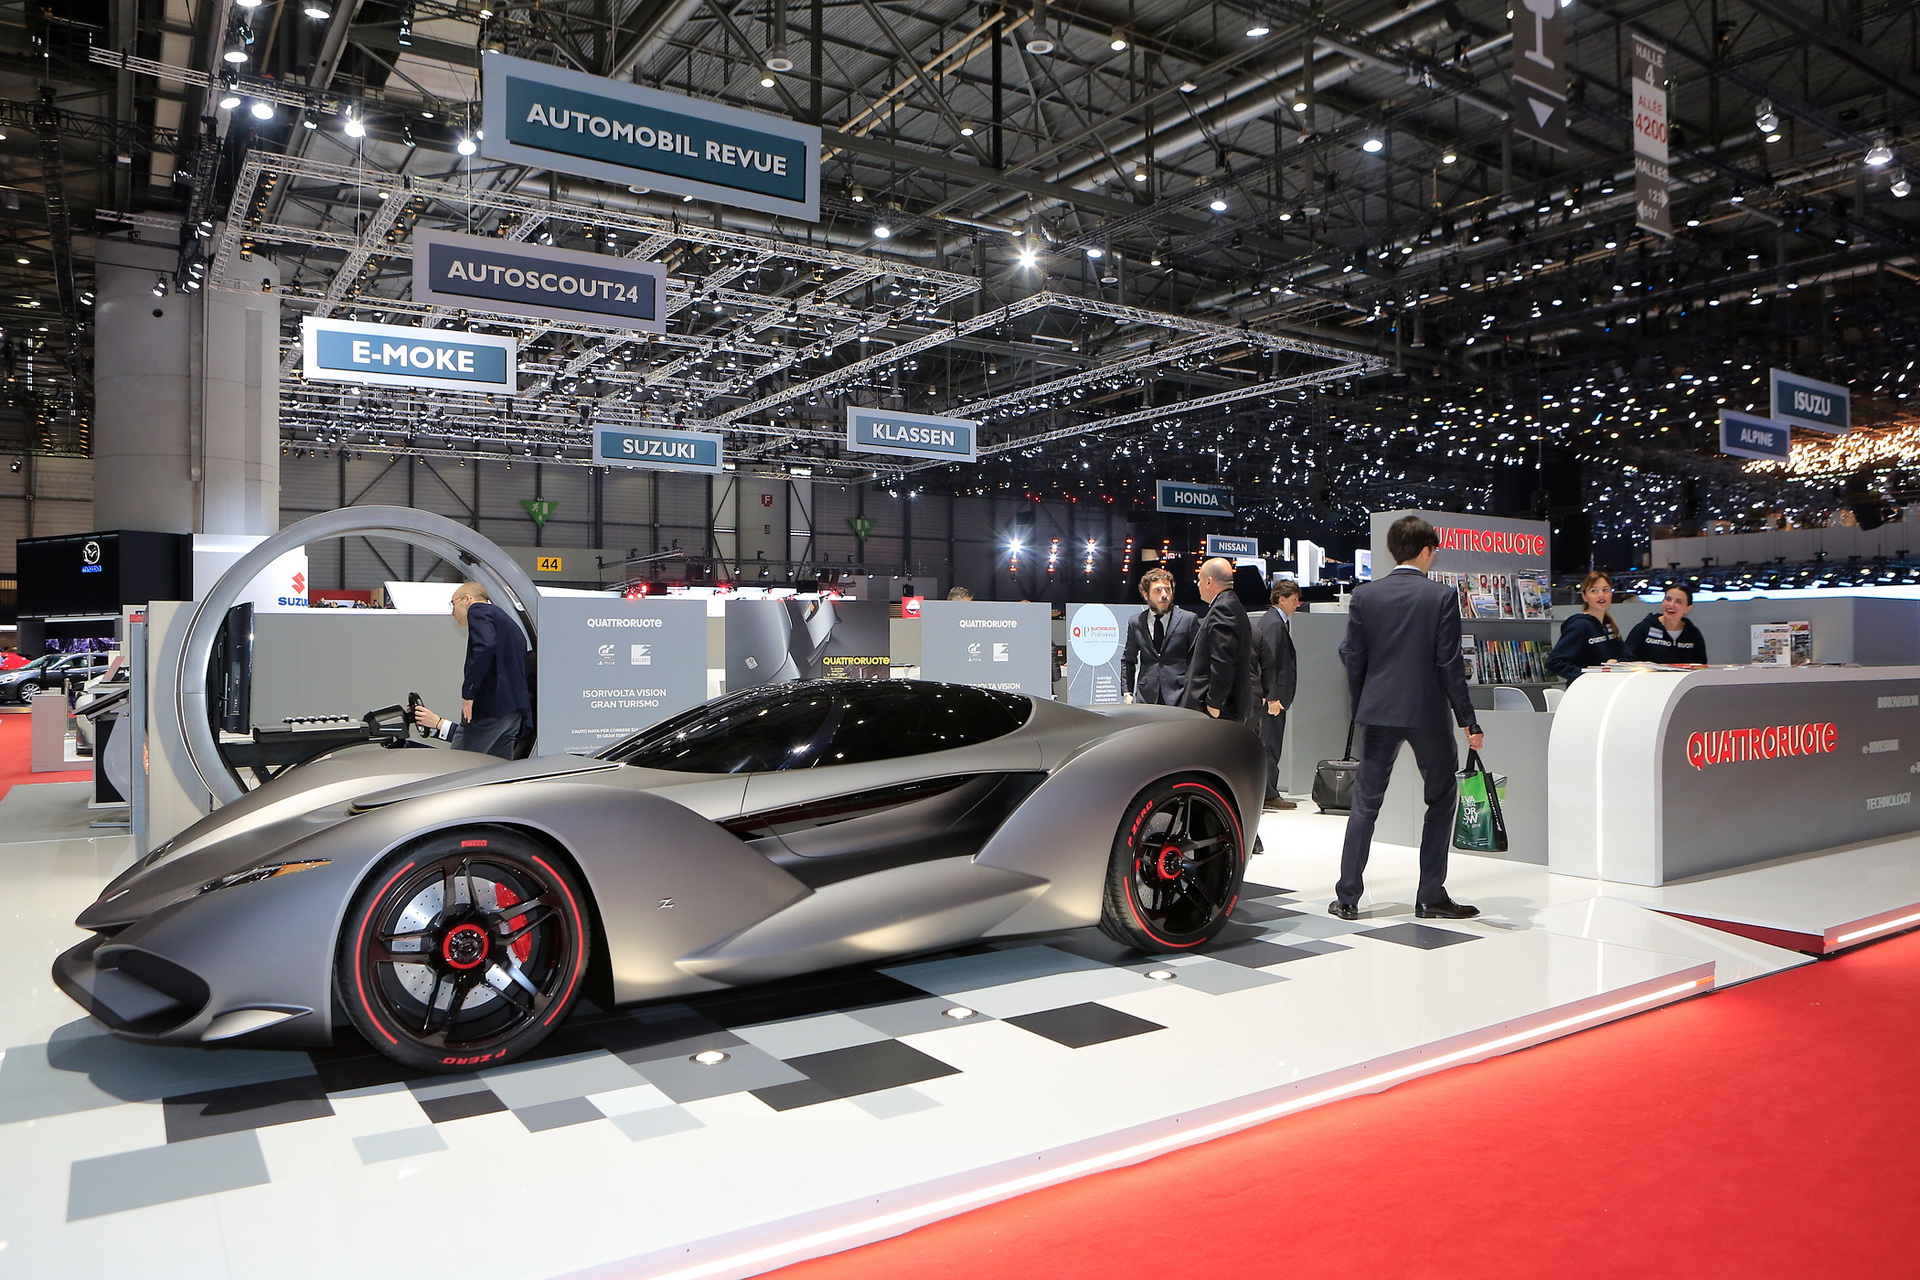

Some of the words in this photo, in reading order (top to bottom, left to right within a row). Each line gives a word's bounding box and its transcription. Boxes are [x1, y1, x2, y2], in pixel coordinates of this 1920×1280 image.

[1635, 44, 1663, 68] HALLE
[1645, 64, 1655, 87] 4
[1635, 113, 1667, 143] 4200
[526, 103, 699, 158] AUTOMOBIL
[705, 140, 787, 177] REVUE
[1635, 157, 1669, 183] HALLES
[447, 260, 638, 304] AUTOSCOUT24
[352, 340, 475, 373] E-MOKE
[1794, 390, 1831, 416] ISUZU
[871, 423, 955, 447] KLASSEN
[1740, 428, 1774, 447] ALPINE
[622, 438, 696, 459] SUZUKI
[1174, 491, 1219, 506] HONDA
[1218, 542, 1248, 552] NISSAN
[1433, 526, 1546, 556] UATTRORUOTe
[541, 558, 558, 570] 44
[582, 689, 635, 698] ISORIVOLTA
[637, 688, 666, 697] VISION
[590, 700, 616, 708] GRAN
[618, 700, 659, 708] TURISMO
[1866, 792, 1912, 810] TECHNOLOGY
[1127, 836, 1132, 848] P
[1131, 799, 1154, 836] ZERO
[442, 1054, 493, 1064] ZERO
[494, 1048, 507, 1058] P
